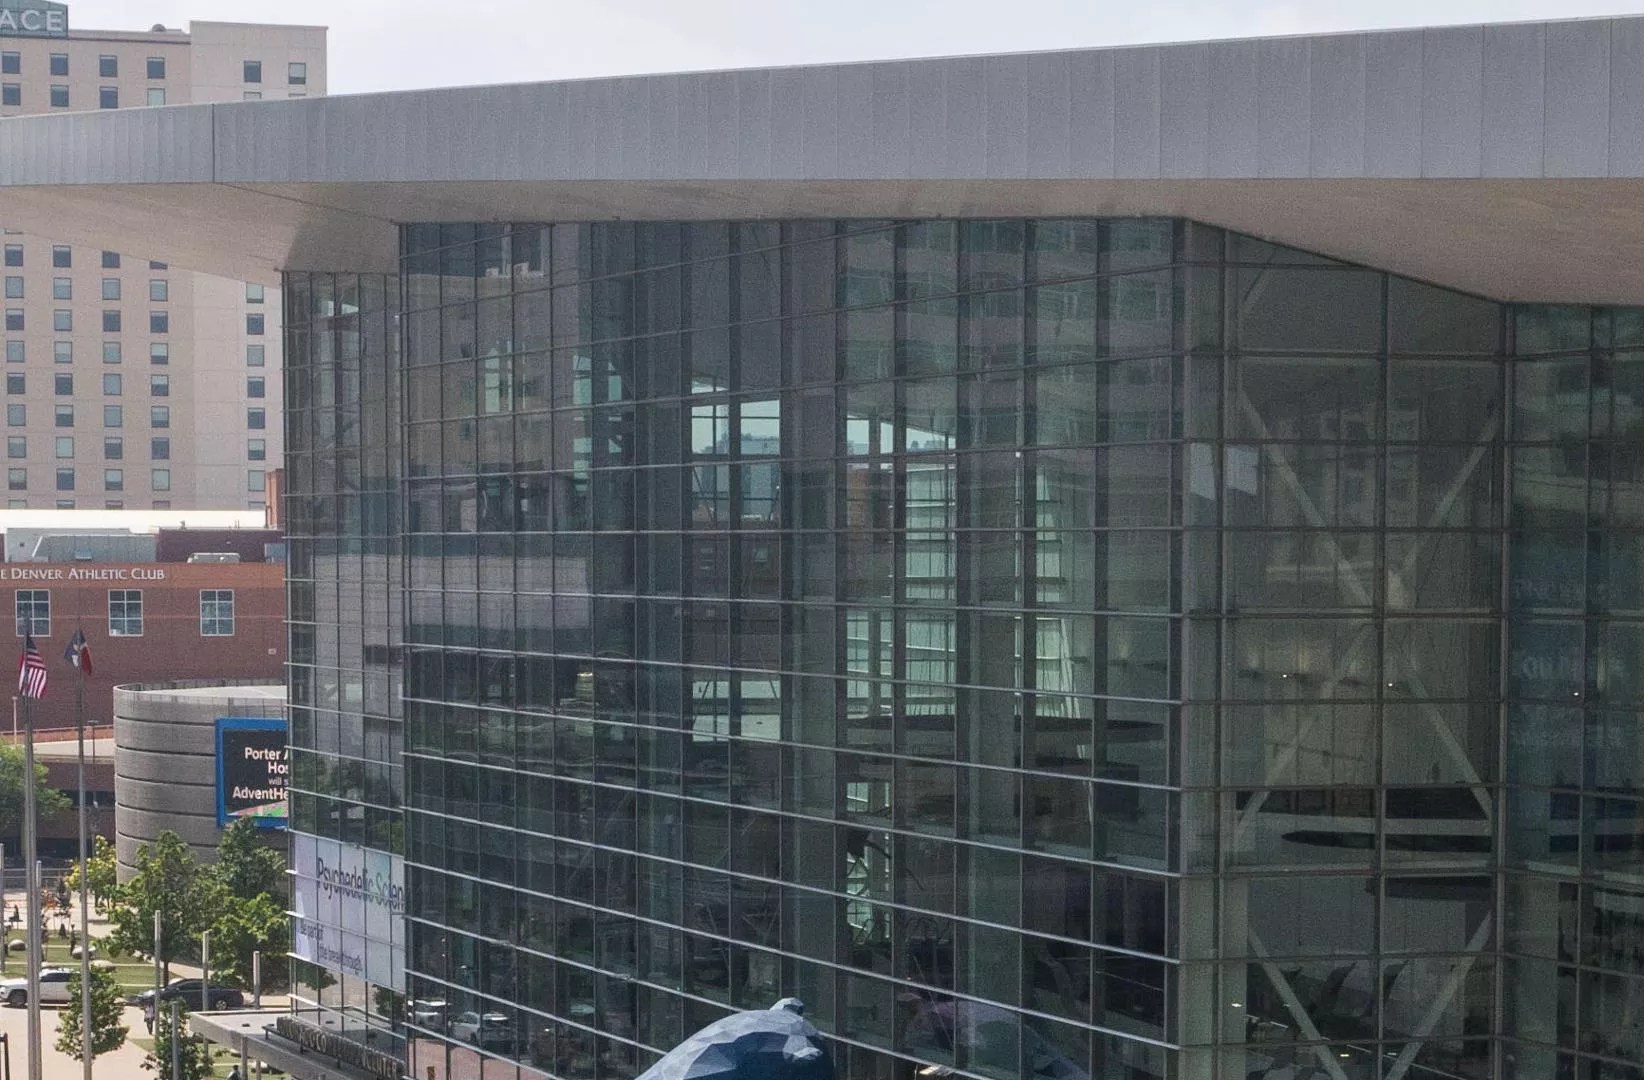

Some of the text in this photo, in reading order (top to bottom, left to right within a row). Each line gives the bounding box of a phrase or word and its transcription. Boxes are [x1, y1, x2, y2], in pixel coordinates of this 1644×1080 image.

[11, 568, 63, 580] DENVER
[68, 568, 126, 580] ATHLETIC
[131, 568, 165, 580] CLUB
[244, 747, 281, 760] Porter
[268, 777, 282, 786] will
[316, 857, 373, 903] Psychedelic
